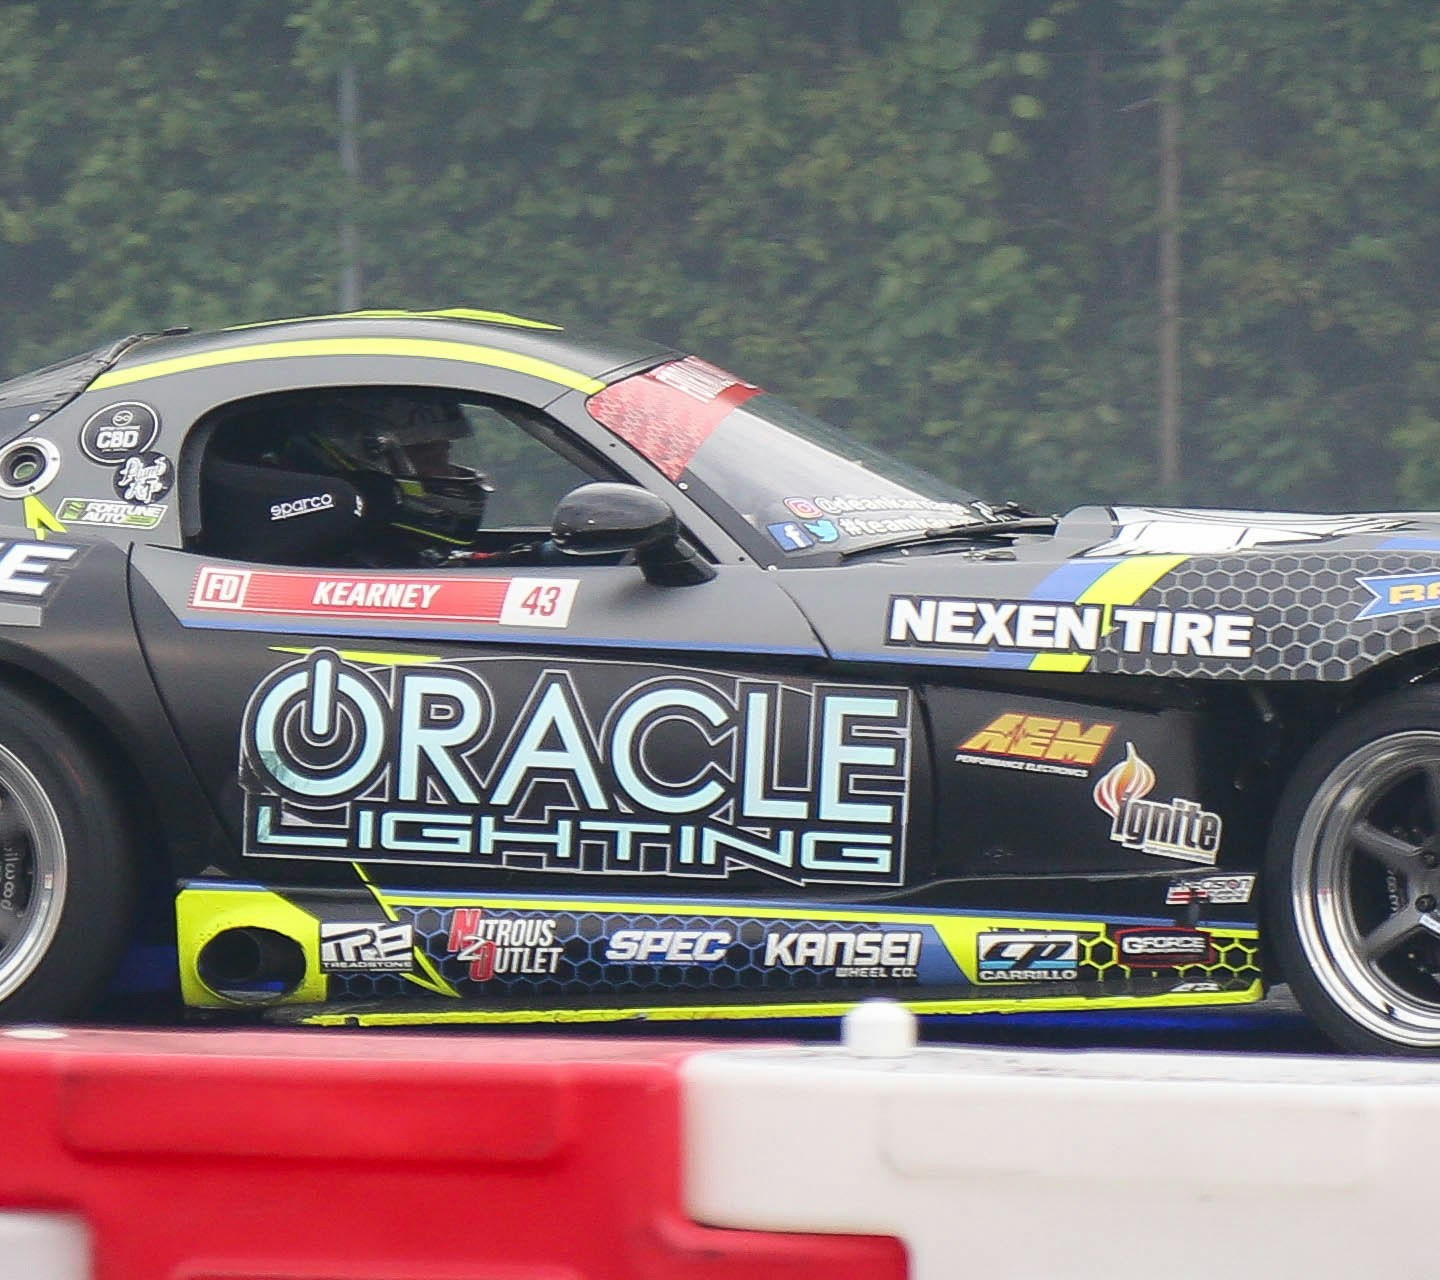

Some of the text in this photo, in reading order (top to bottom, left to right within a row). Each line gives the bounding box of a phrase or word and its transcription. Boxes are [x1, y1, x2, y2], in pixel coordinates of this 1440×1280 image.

[97, 431, 139, 449] CBD
[81, 512, 126, 523] AUTO
[85, 503, 160, 517] FORTUNE
[270, 493, 334, 519] sparco
[205, 575, 561, 617] FD KEARNEY 43
[889, 598, 1255, 658] NEXEN TIRE
[254, 658, 900, 824] ORACLE
[958, 712, 1117, 767] AEM
[257, 805, 893, 873] LIGHTING
[448, 908, 556, 953] NITROUS
[605, 930, 733, 961] SPEC
[323, 961, 412, 969] TREADSTONE
[764, 932, 923, 967] KANSEI
[835, 967, 888, 978] WHEEL
[979, 970, 1078, 981] CARRILLO
